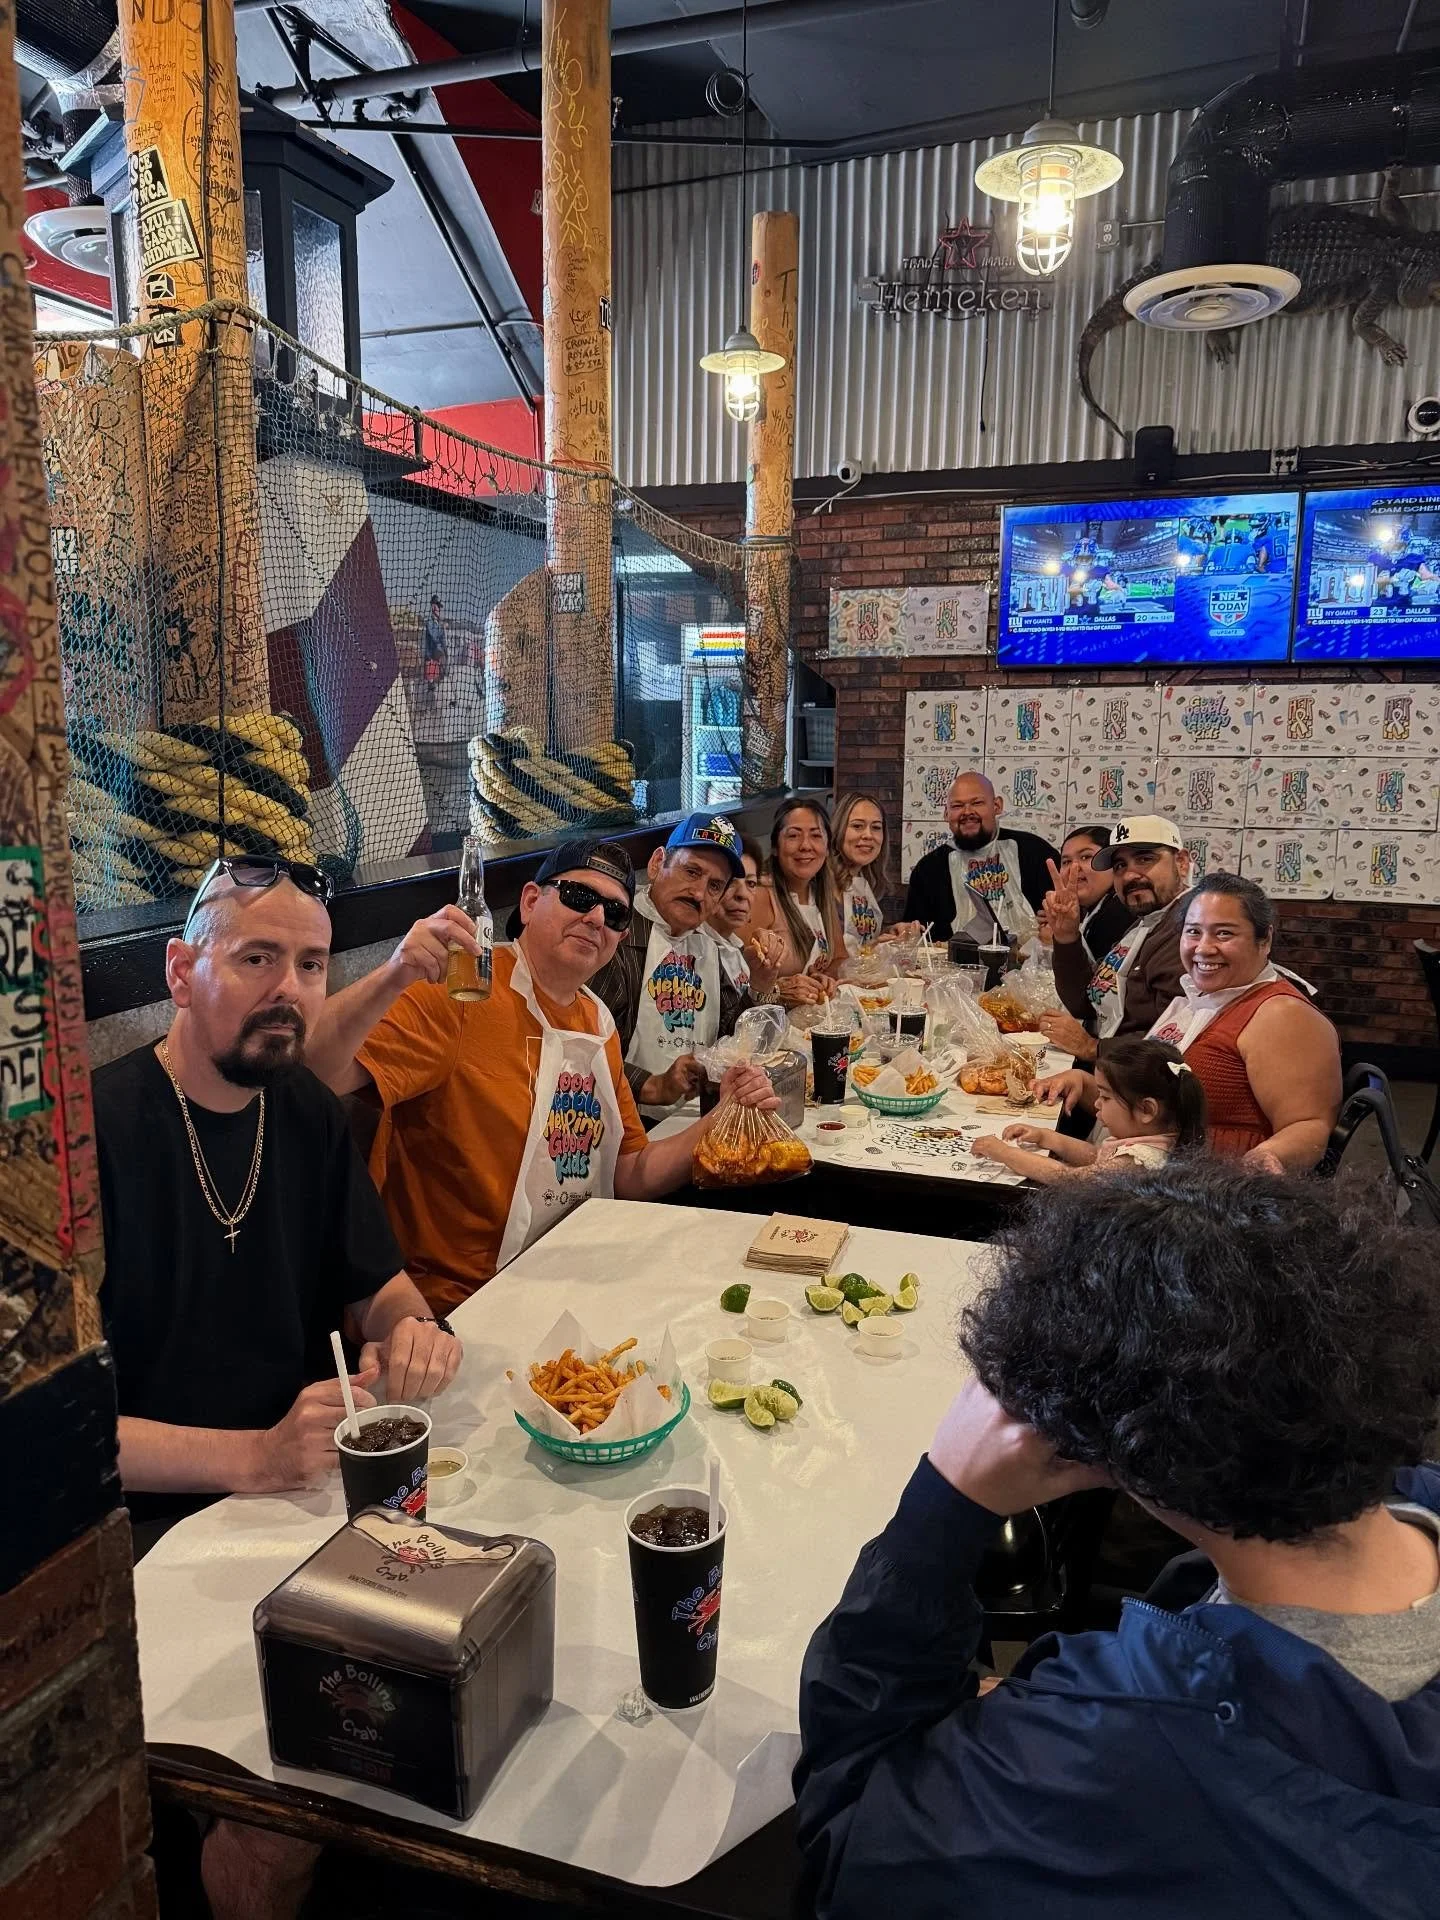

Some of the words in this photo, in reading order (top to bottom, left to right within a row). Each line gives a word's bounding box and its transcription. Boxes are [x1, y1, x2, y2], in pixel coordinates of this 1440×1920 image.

[903, 258, 939, 268] TRADE
[875, 280, 1043, 313] Heineken
[1211, 602, 1247, 611] TODAY
[1219, 592, 1242, 601] NFL
[1405, 607, 1431, 615] DALLAS
[548, 1128, 592, 1160] Good
[555, 1153, 591, 1185] Kids
[671, 1587, 705, 1621] The
[319, 1670, 342, 1694] The
[345, 1664, 396, 1712] Boiling
